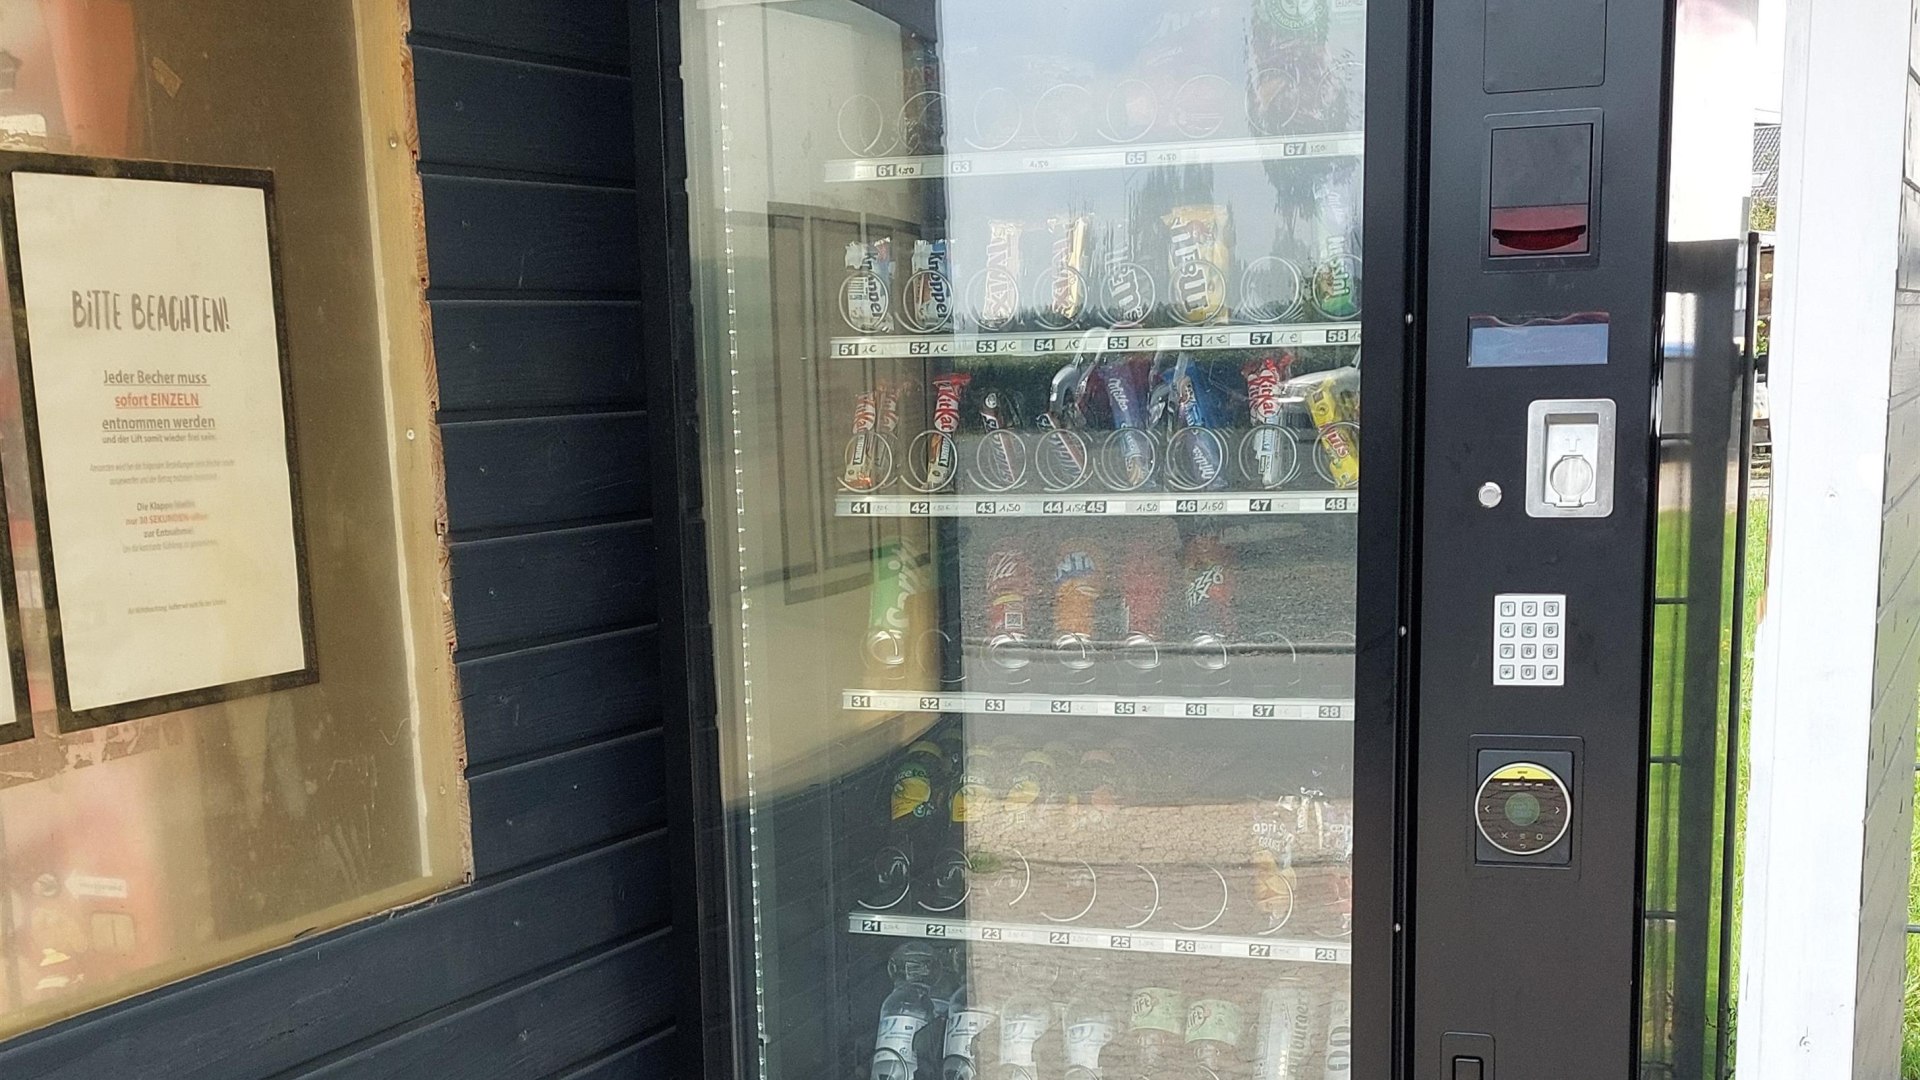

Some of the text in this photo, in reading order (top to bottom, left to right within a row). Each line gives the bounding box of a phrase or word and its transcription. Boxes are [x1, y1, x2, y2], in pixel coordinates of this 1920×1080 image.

[1285, 143, 1304, 156] 67
[1127, 152, 1145, 164] 65
[877, 165, 896, 177] 61
[952, 161, 970, 173] 63
[131, 292, 231, 333] BEACHTEN!
[1182, 335, 1201, 346] 56
[1252, 333, 1270, 344] 57
[1327, 331, 1347, 342] 58
[979, 341, 995, 352] 53
[1036, 339, 1054, 350] 54
[1109, 337, 1127, 348] 55
[840, 344, 856, 355] 51
[911, 343, 928, 354] 52
[103, 369, 208, 384] Jeder Becher muss
[114, 392, 199, 407] sofort EINZELN
[102, 414, 216, 430] entnommen werden
[852, 502, 868, 513] 41
[911, 502, 928, 513] 42
[977, 502, 994, 513] 43
[1045, 502, 1063, 513] 44
[1087, 502, 1104, 513] 45
[1178, 501, 1196, 512] 46
[1251, 500, 1269, 511] 47
[1326, 499, 1346, 511] 48
[852, 696, 868, 707] 31
[921, 698, 938, 709] 32
[986, 700, 1003, 711] 33
[1053, 701, 1070, 712] 34
[1116, 703, 1134, 714] 35
[1187, 704, 1205, 715] 36
[1254, 705, 1273, 716] 37
[1320, 706, 1340, 718] 38
[864, 921, 878, 931] 21
[928, 925, 944, 935] 22
[983, 928, 1000, 939] 23
[1051, 932, 1069, 943] 24
[1112, 936, 1129, 948] 25
[1177, 940, 1194, 952] 26
[1250, 945, 1269, 956] 27
[1317, 949, 1335, 960] 28
